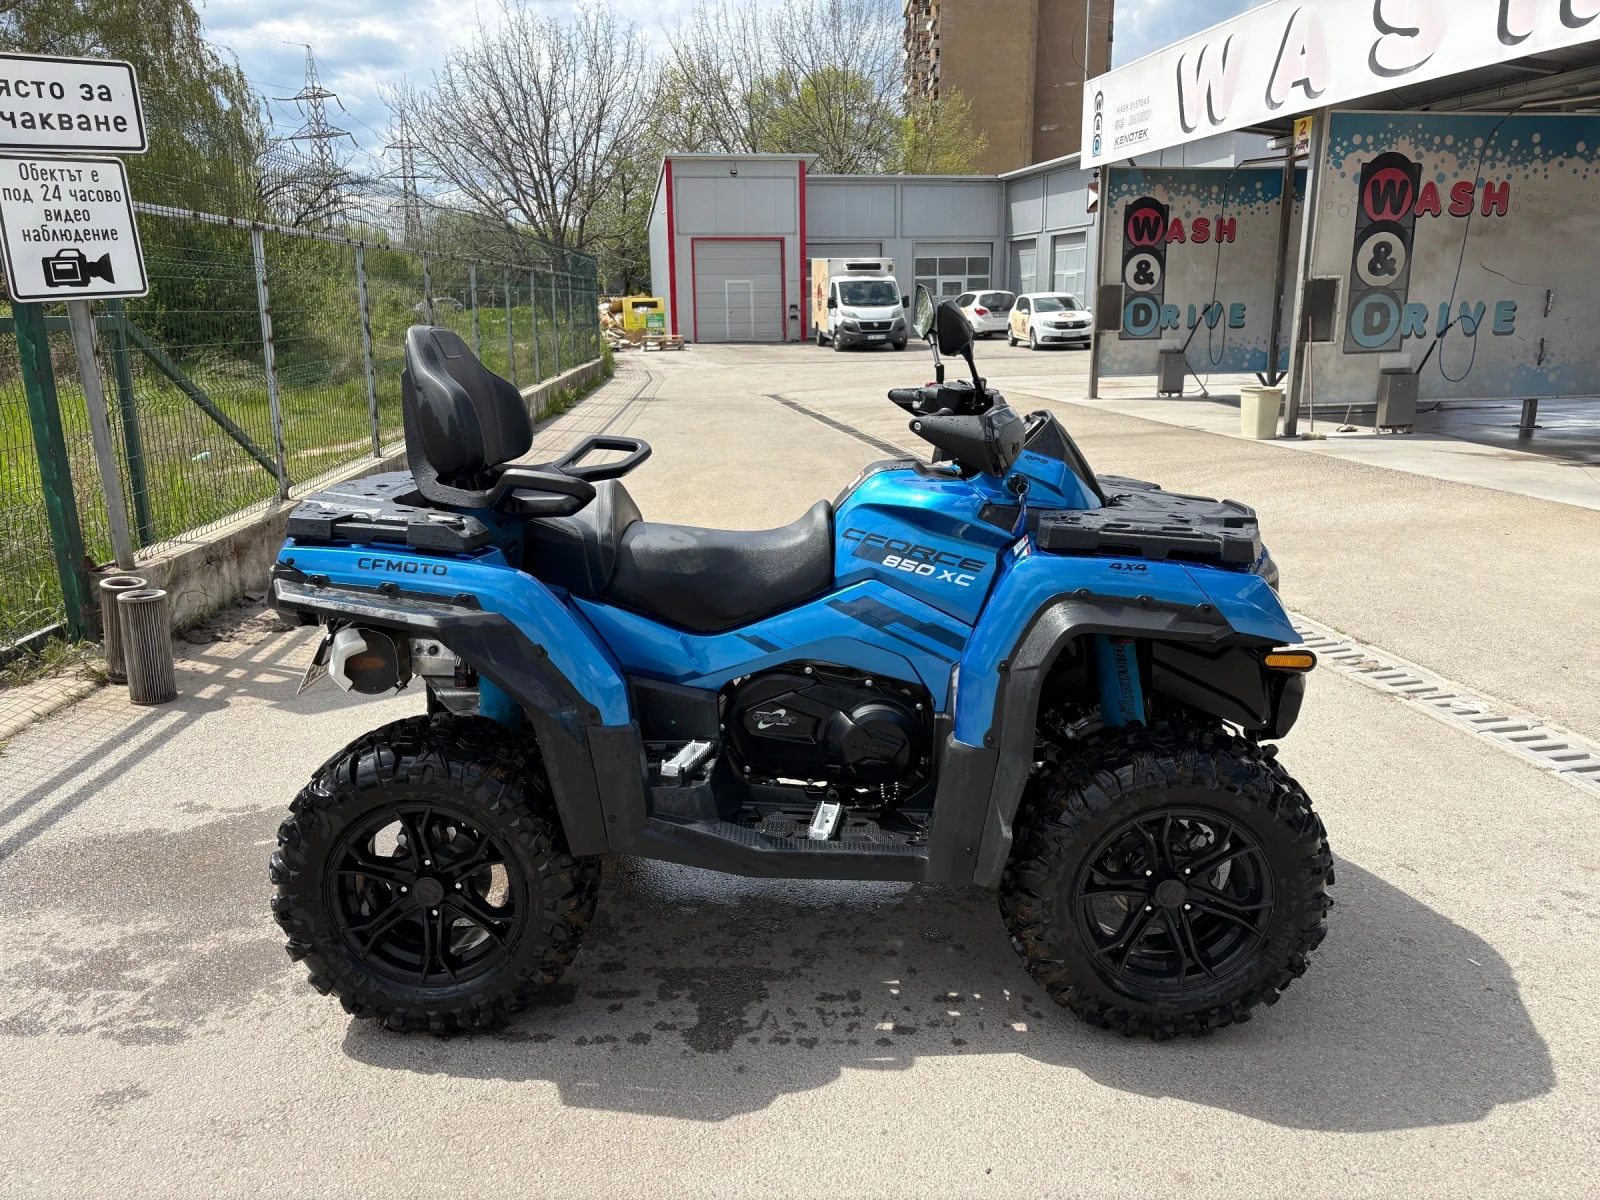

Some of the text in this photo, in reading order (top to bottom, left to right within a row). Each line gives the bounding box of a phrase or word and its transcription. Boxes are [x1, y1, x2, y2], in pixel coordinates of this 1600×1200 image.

[79, 83, 113, 102] за
[0, 111, 128, 133] чакване
[1299, 120, 1307, 136] 2
[1113, 128, 1149, 147] KENOTEK
[18, 162, 100, 183] Обектът е
[2, 184, 122, 203] под 24 часово
[1370, 178, 1510, 218] WASH
[43, 208, 91, 224] видео
[21, 224, 119, 243] наблюдение
[1132, 215, 1237, 244] WASH
[1367, 240, 1397, 277] &
[1133, 259, 1155, 285] &
[1131, 302, 1247, 331] DRIVE
[1362, 300, 1518, 340] DRIVE
[841, 527, 987, 573] CFORCE
[357, 557, 448, 577] CFMOTO
[882, 554, 977, 588] 850 XC
